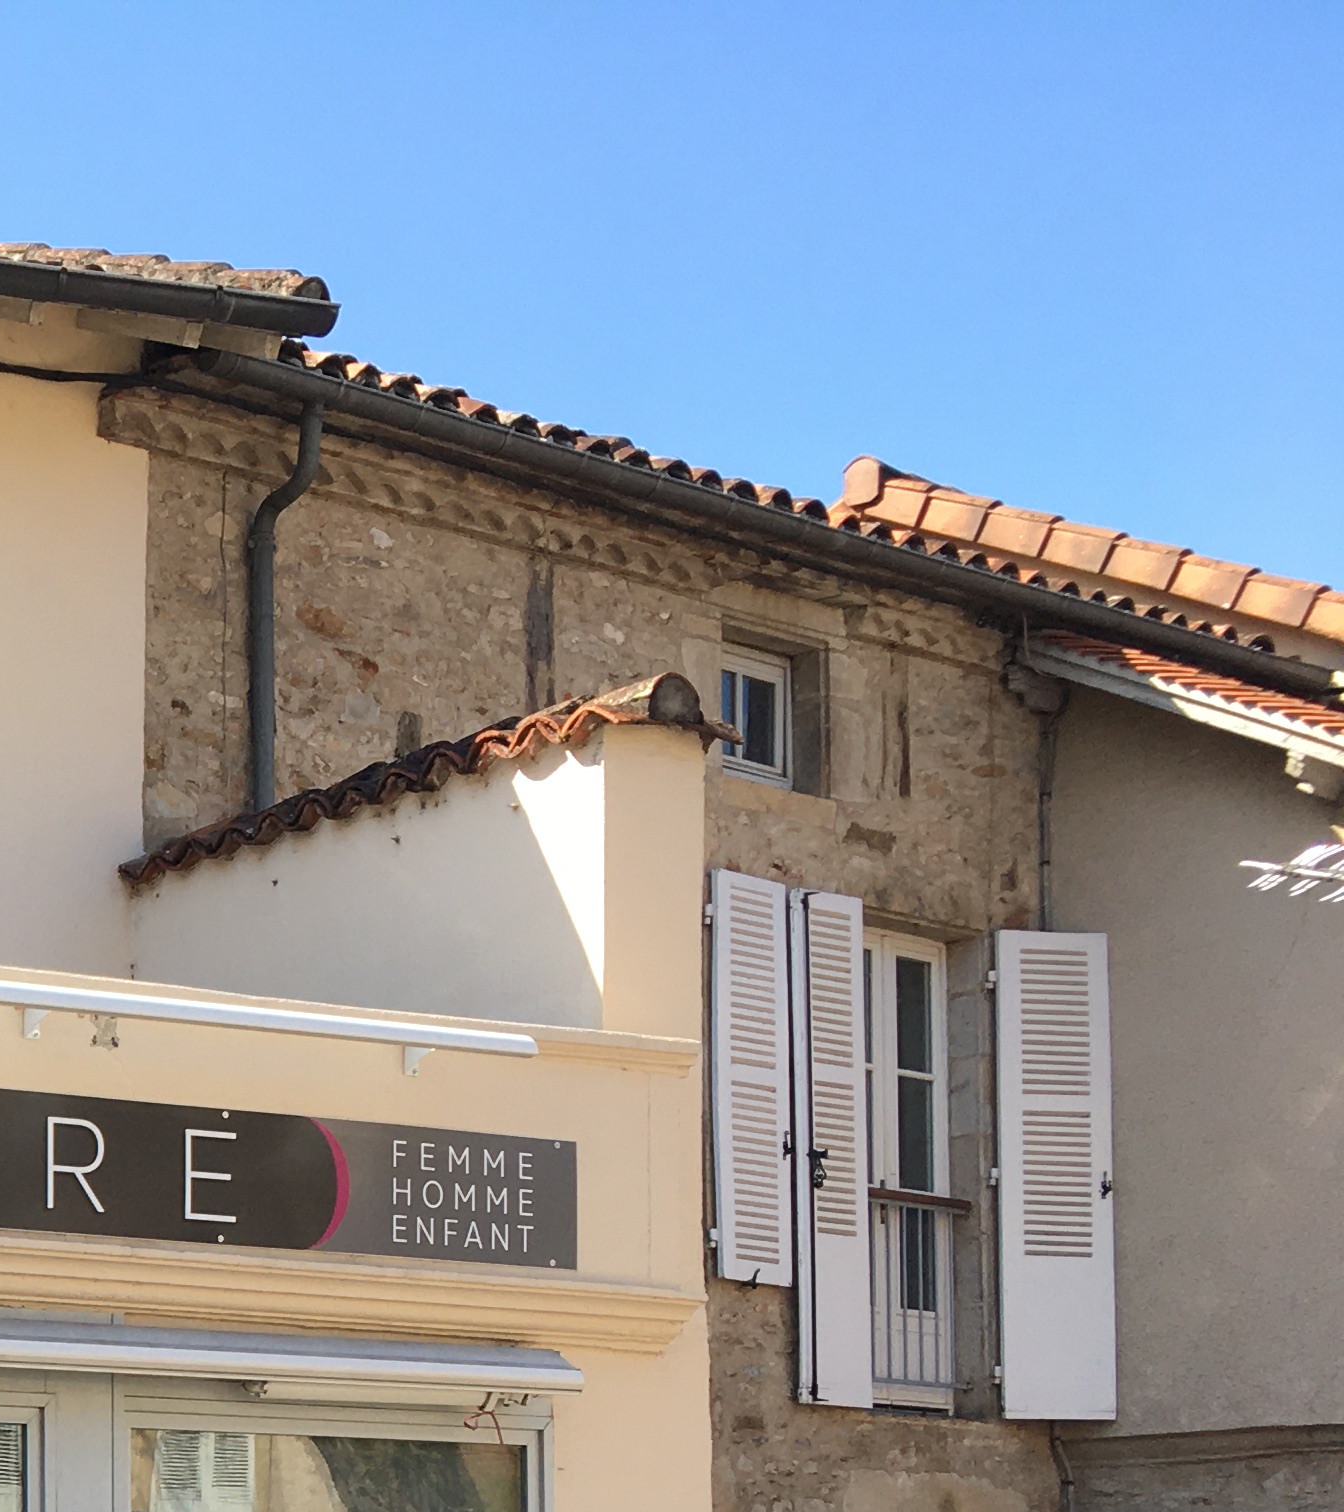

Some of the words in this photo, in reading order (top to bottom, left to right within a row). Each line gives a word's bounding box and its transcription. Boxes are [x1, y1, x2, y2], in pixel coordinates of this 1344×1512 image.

[392, 1139, 534, 1181] FEMME
[392, 1177, 534, 1217] HOMME
[392, 1214, 535, 1253] ENFANT
